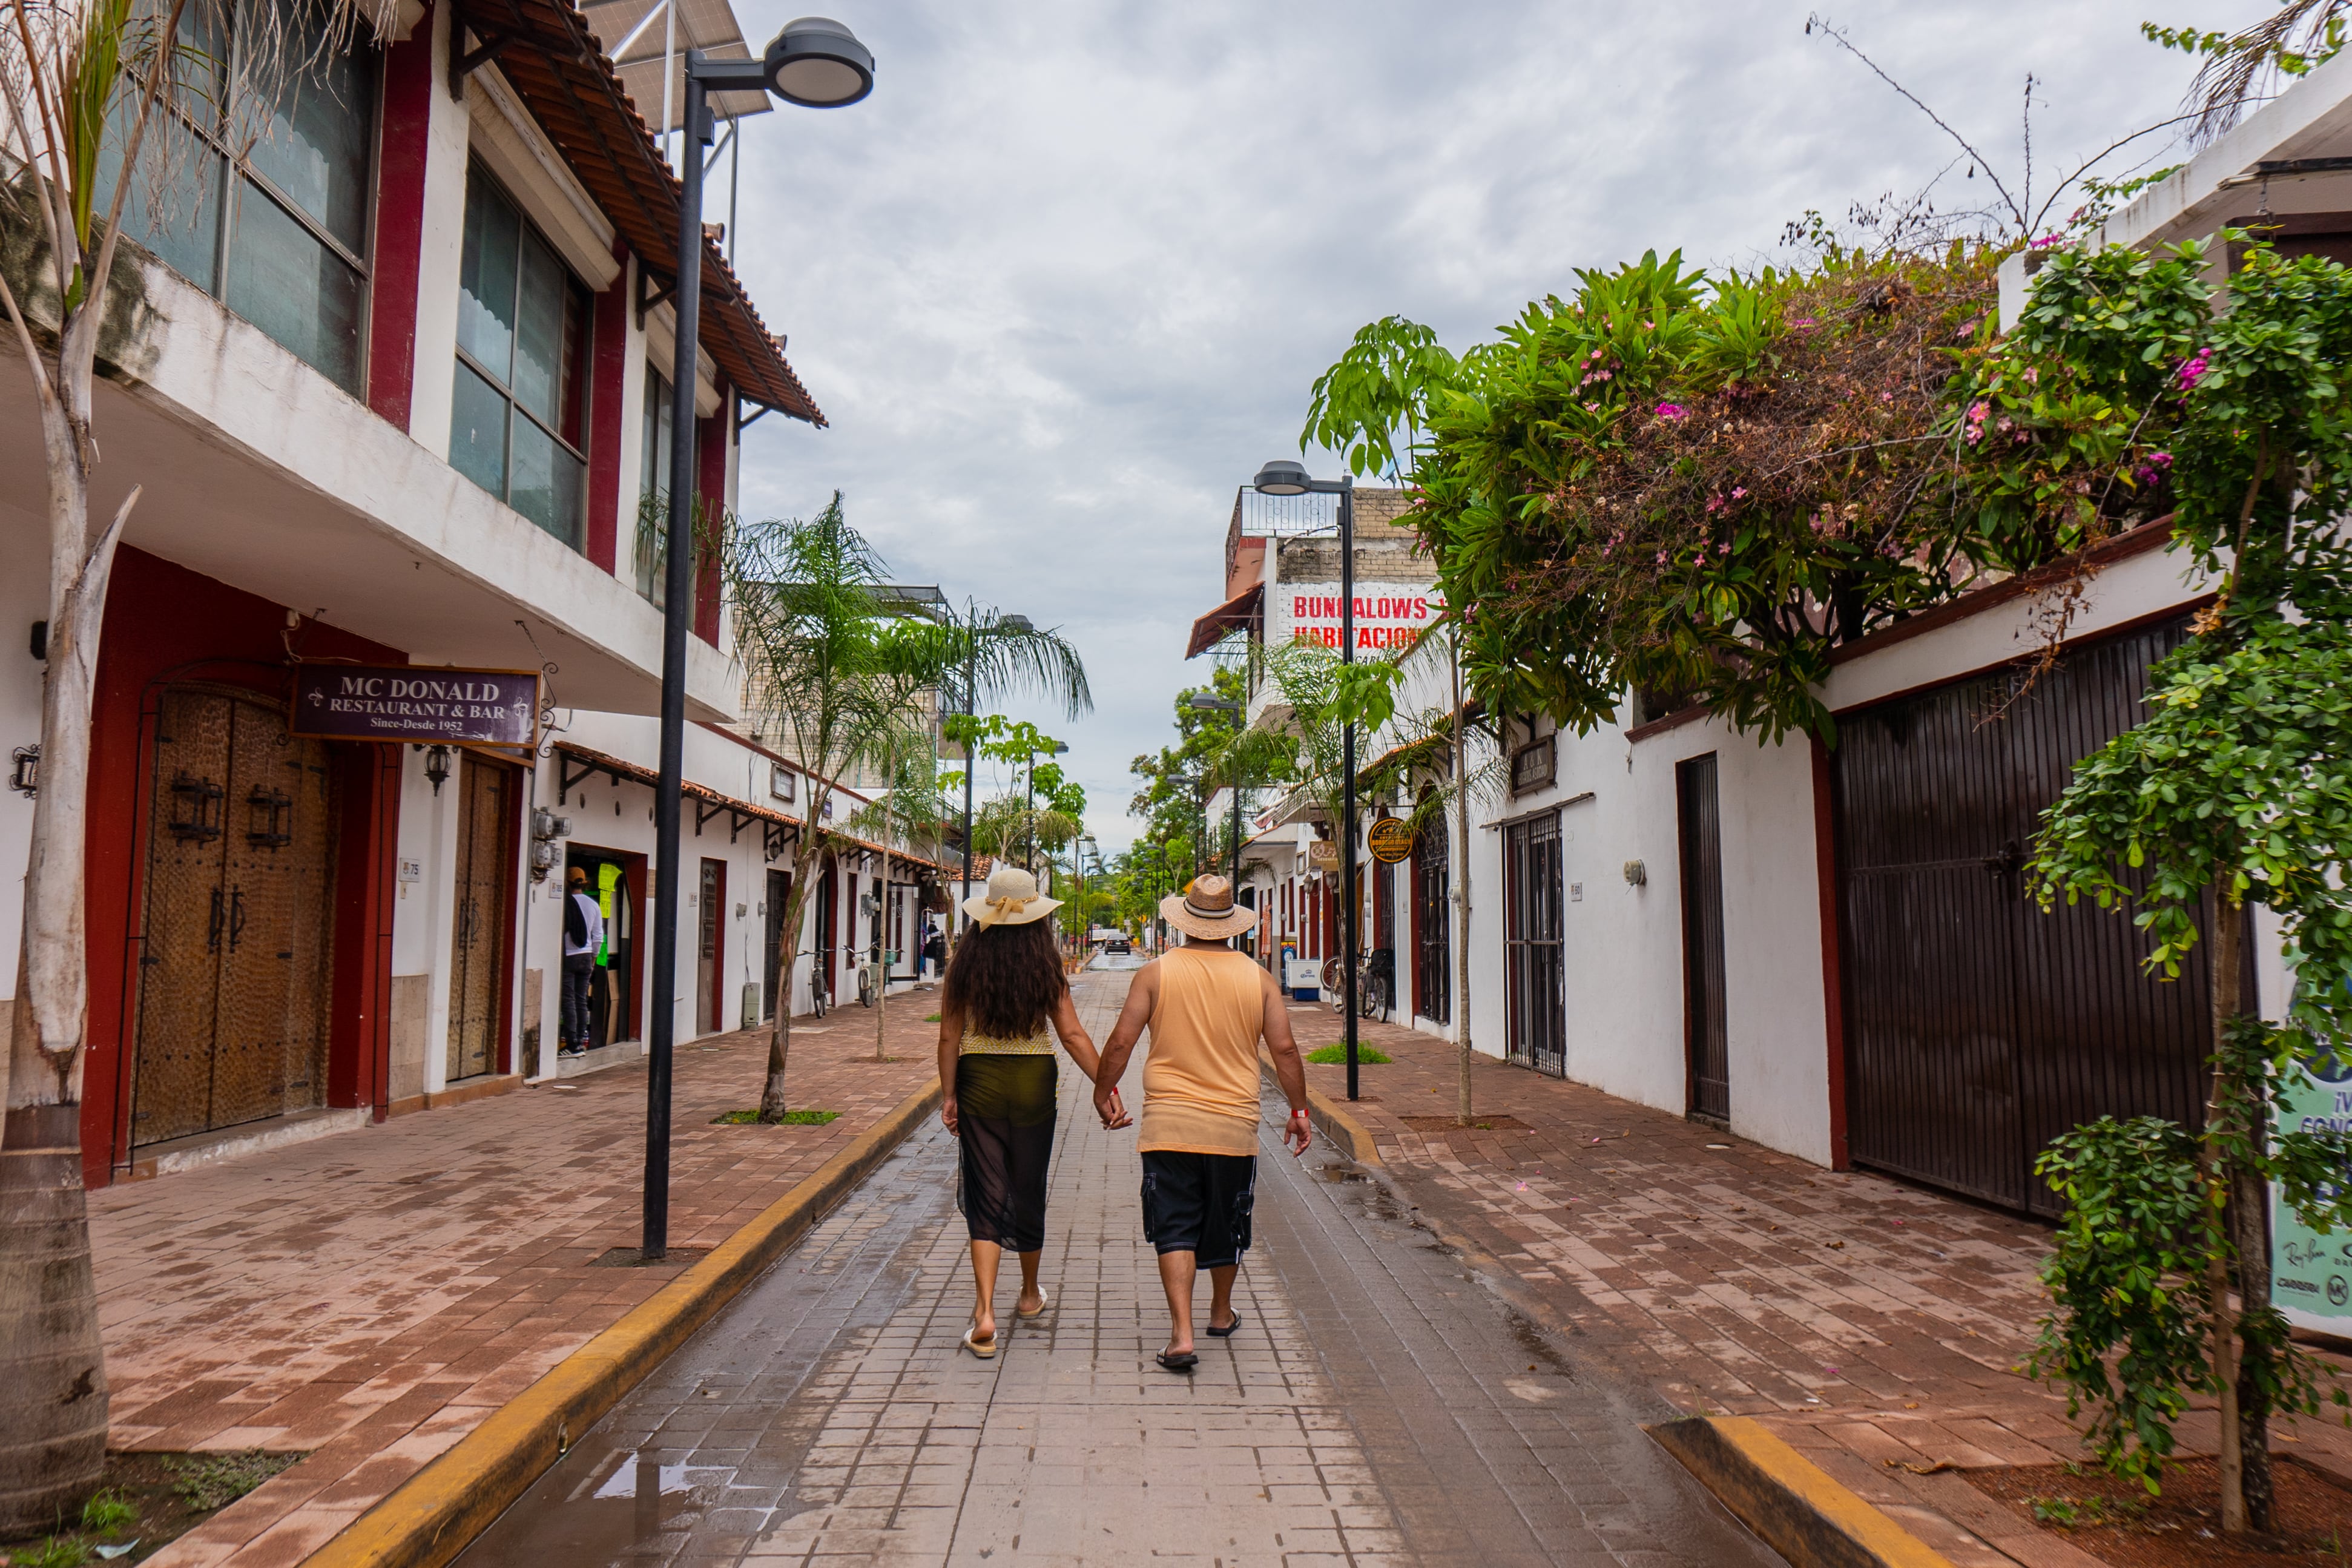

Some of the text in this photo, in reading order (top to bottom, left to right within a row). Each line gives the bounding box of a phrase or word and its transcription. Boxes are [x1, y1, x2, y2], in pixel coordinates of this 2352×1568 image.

[340, 676, 499, 702] MC DONALD
[330, 699, 505, 719] RESTAURANT & BAR
[438, 721, 463, 731] 1952
[410, 863, 419, 875] 75
